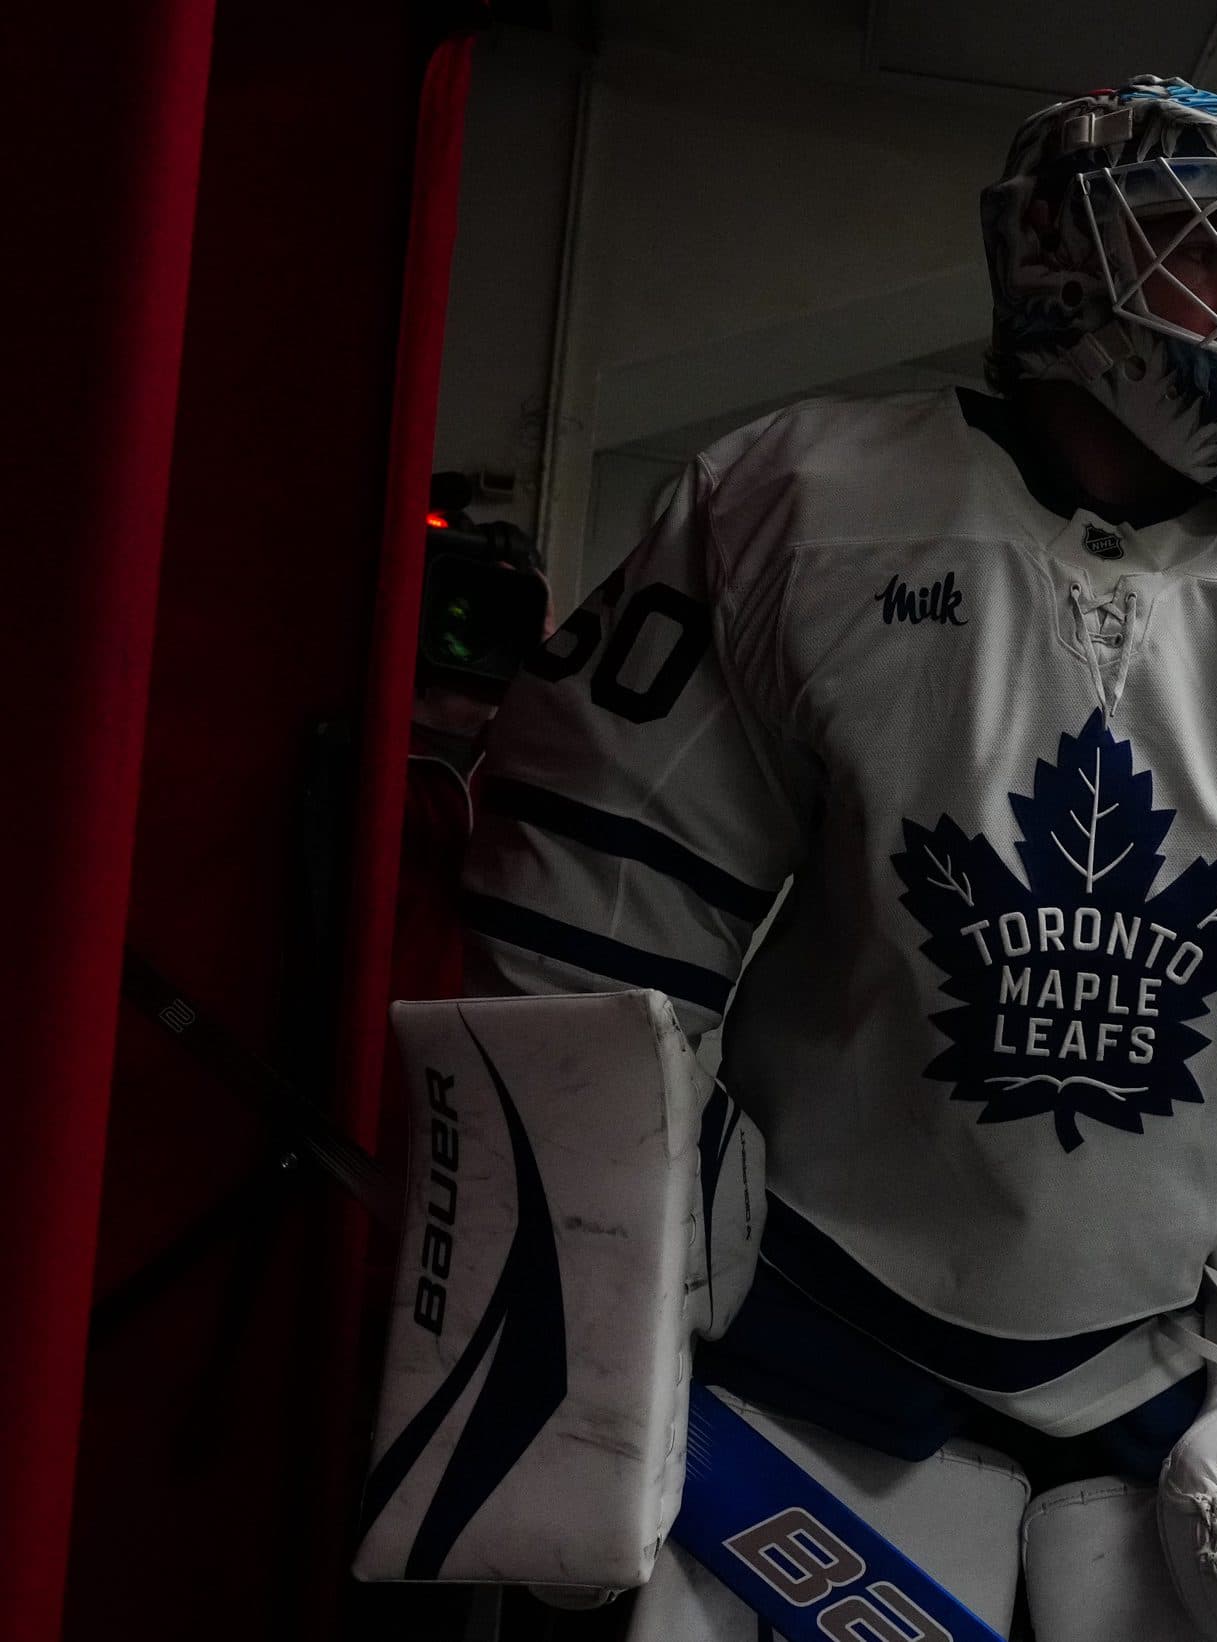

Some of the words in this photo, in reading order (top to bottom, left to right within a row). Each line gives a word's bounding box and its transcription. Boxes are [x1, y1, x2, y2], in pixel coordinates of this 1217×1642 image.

[874, 571, 968, 626] Milk
[960, 906, 1204, 986] TORONTO
[999, 964, 1162, 1017] MAPLE
[993, 1013, 1156, 1065] LEAFS
[414, 1066, 458, 1336] BAUER
